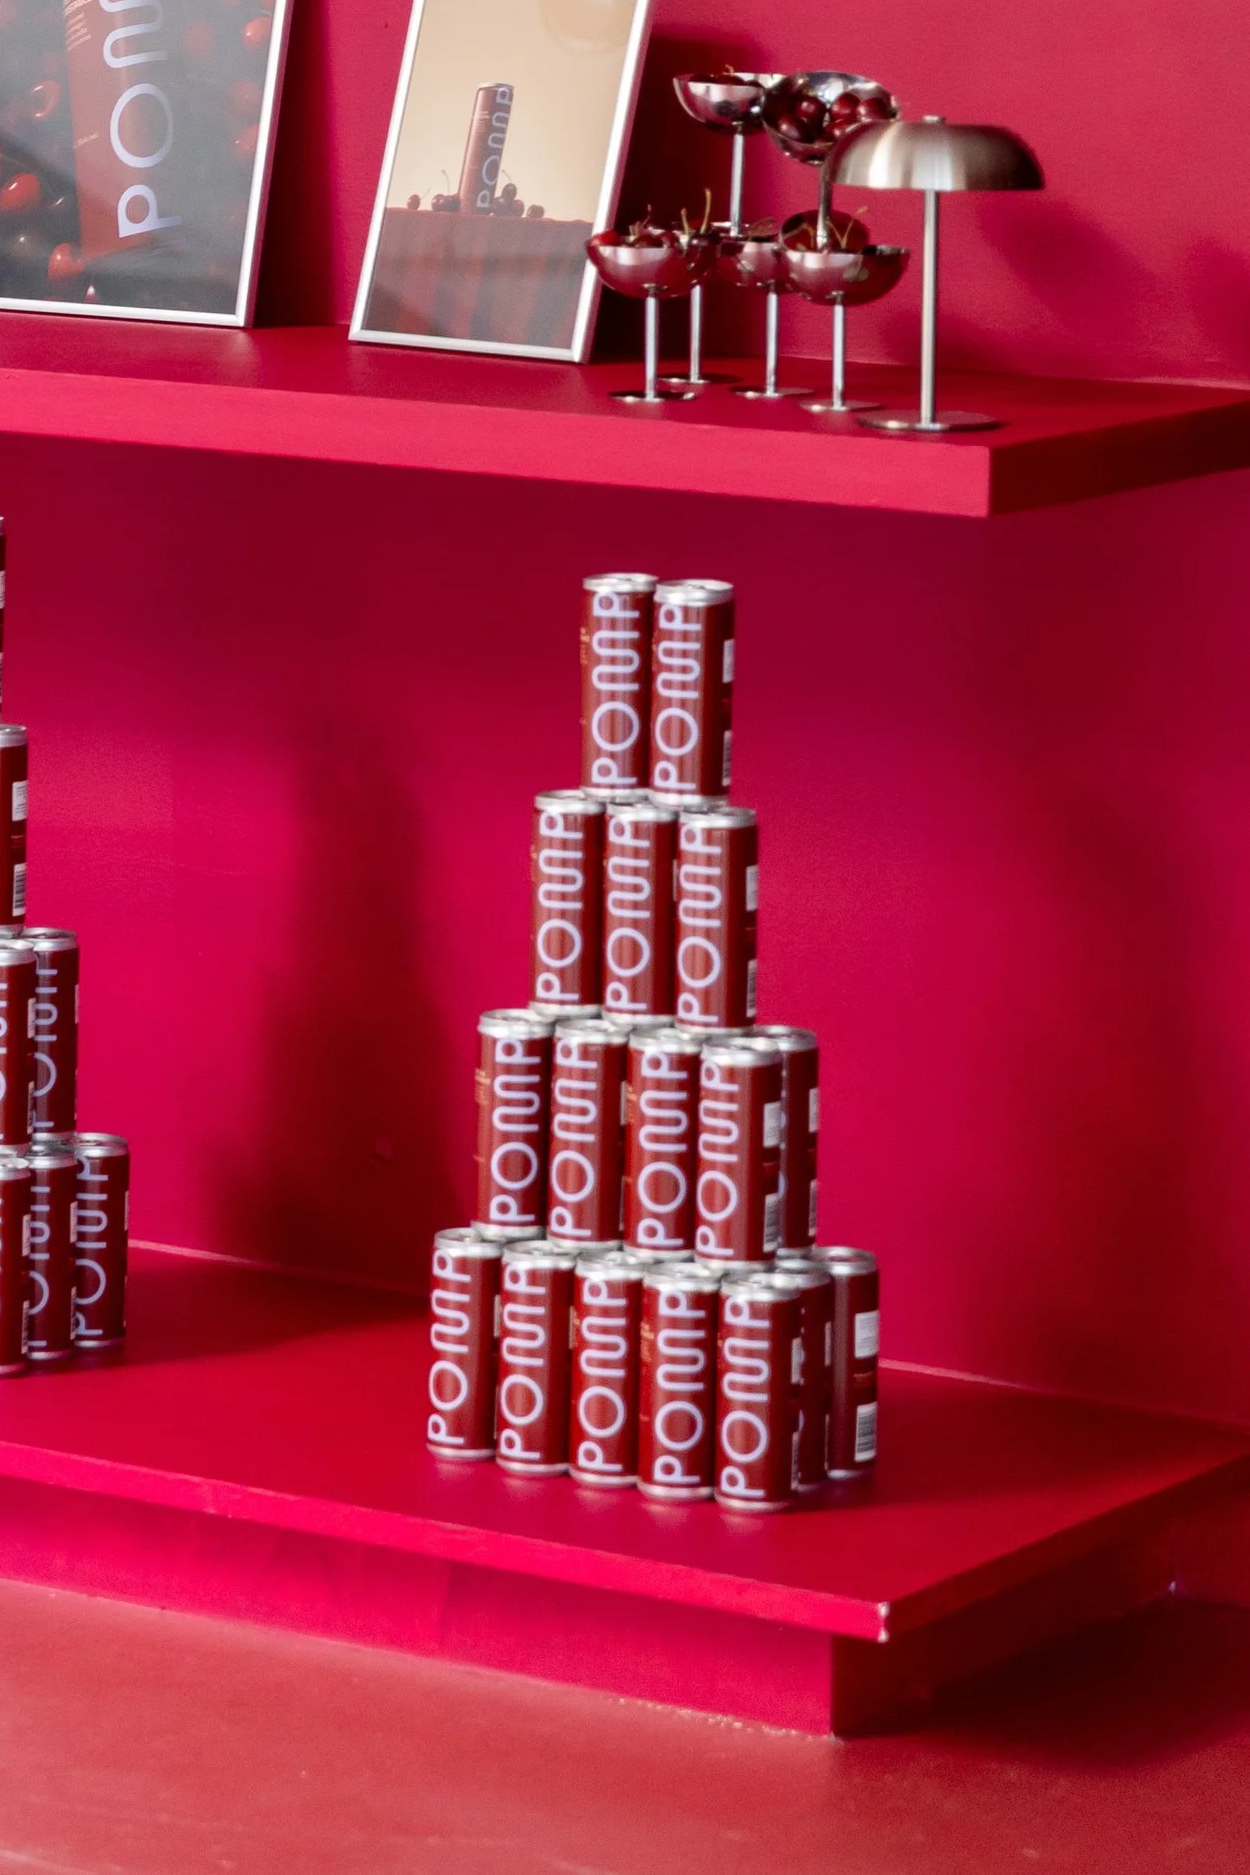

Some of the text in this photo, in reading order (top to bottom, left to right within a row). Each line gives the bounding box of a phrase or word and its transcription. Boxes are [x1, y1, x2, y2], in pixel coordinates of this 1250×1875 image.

[591, 590, 641, 785] POMP
[654, 603, 703, 790] POMP
[536, 811, 584, 1003] POMP
[605, 814, 651, 1011] POMP
[677, 824, 723, 1023] POMP
[489, 1038, 541, 1223] POMP
[549, 1039, 598, 1237] POMP
[636, 1048, 688, 1248] POMP
[695, 1056, 740, 1257] POMP
[427, 1246, 473, 1446] POMP
[500, 1262, 547, 1460] POMP
[577, 1276, 627, 1472] POMP
[653, 1286, 706, 1484] POMP
[720, 1296, 771, 1497] POMP
